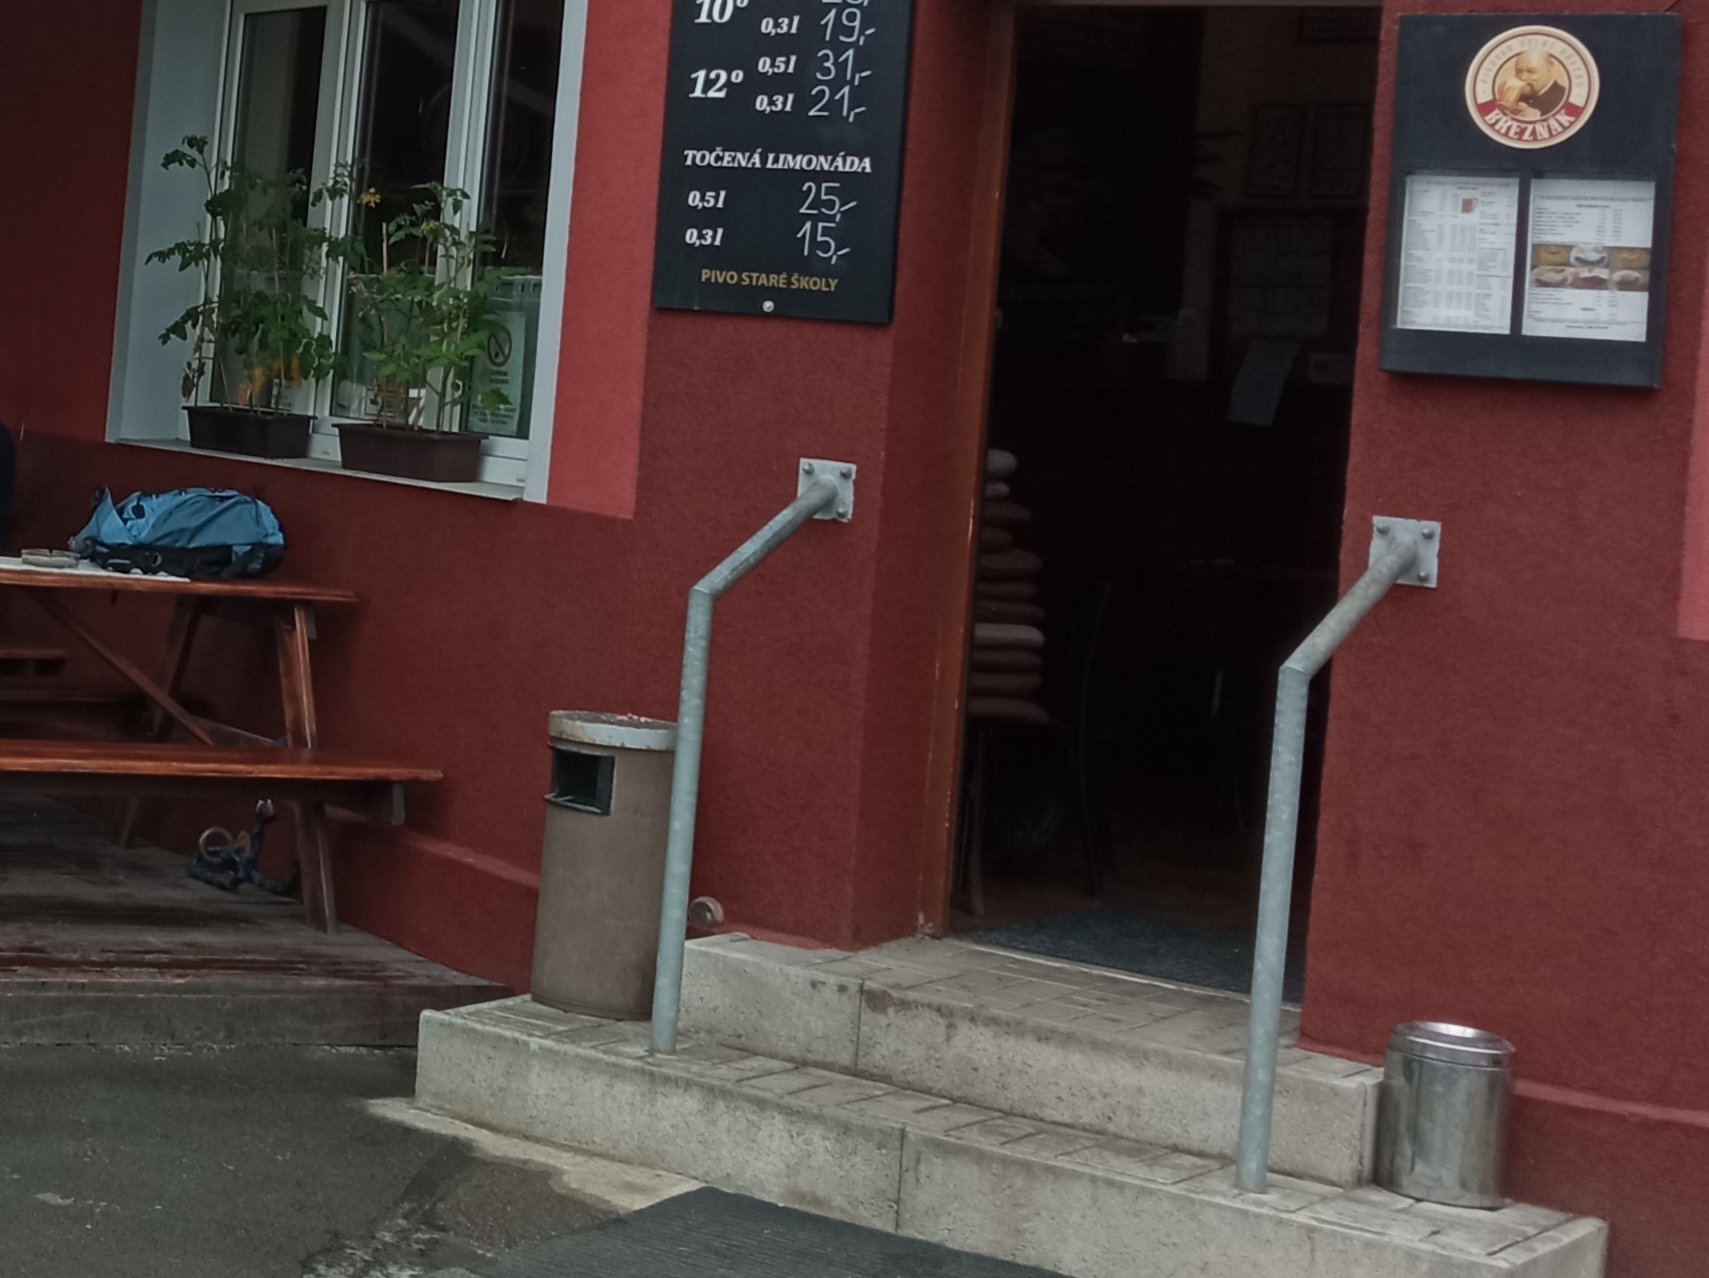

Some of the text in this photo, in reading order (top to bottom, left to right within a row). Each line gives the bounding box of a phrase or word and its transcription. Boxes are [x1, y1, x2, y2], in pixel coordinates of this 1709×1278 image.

[683, 146, 872, 173] TOČENÁ LIMONÁDA
[700, 268, 839, 292] PIVO STARÉ ŠKOLY
